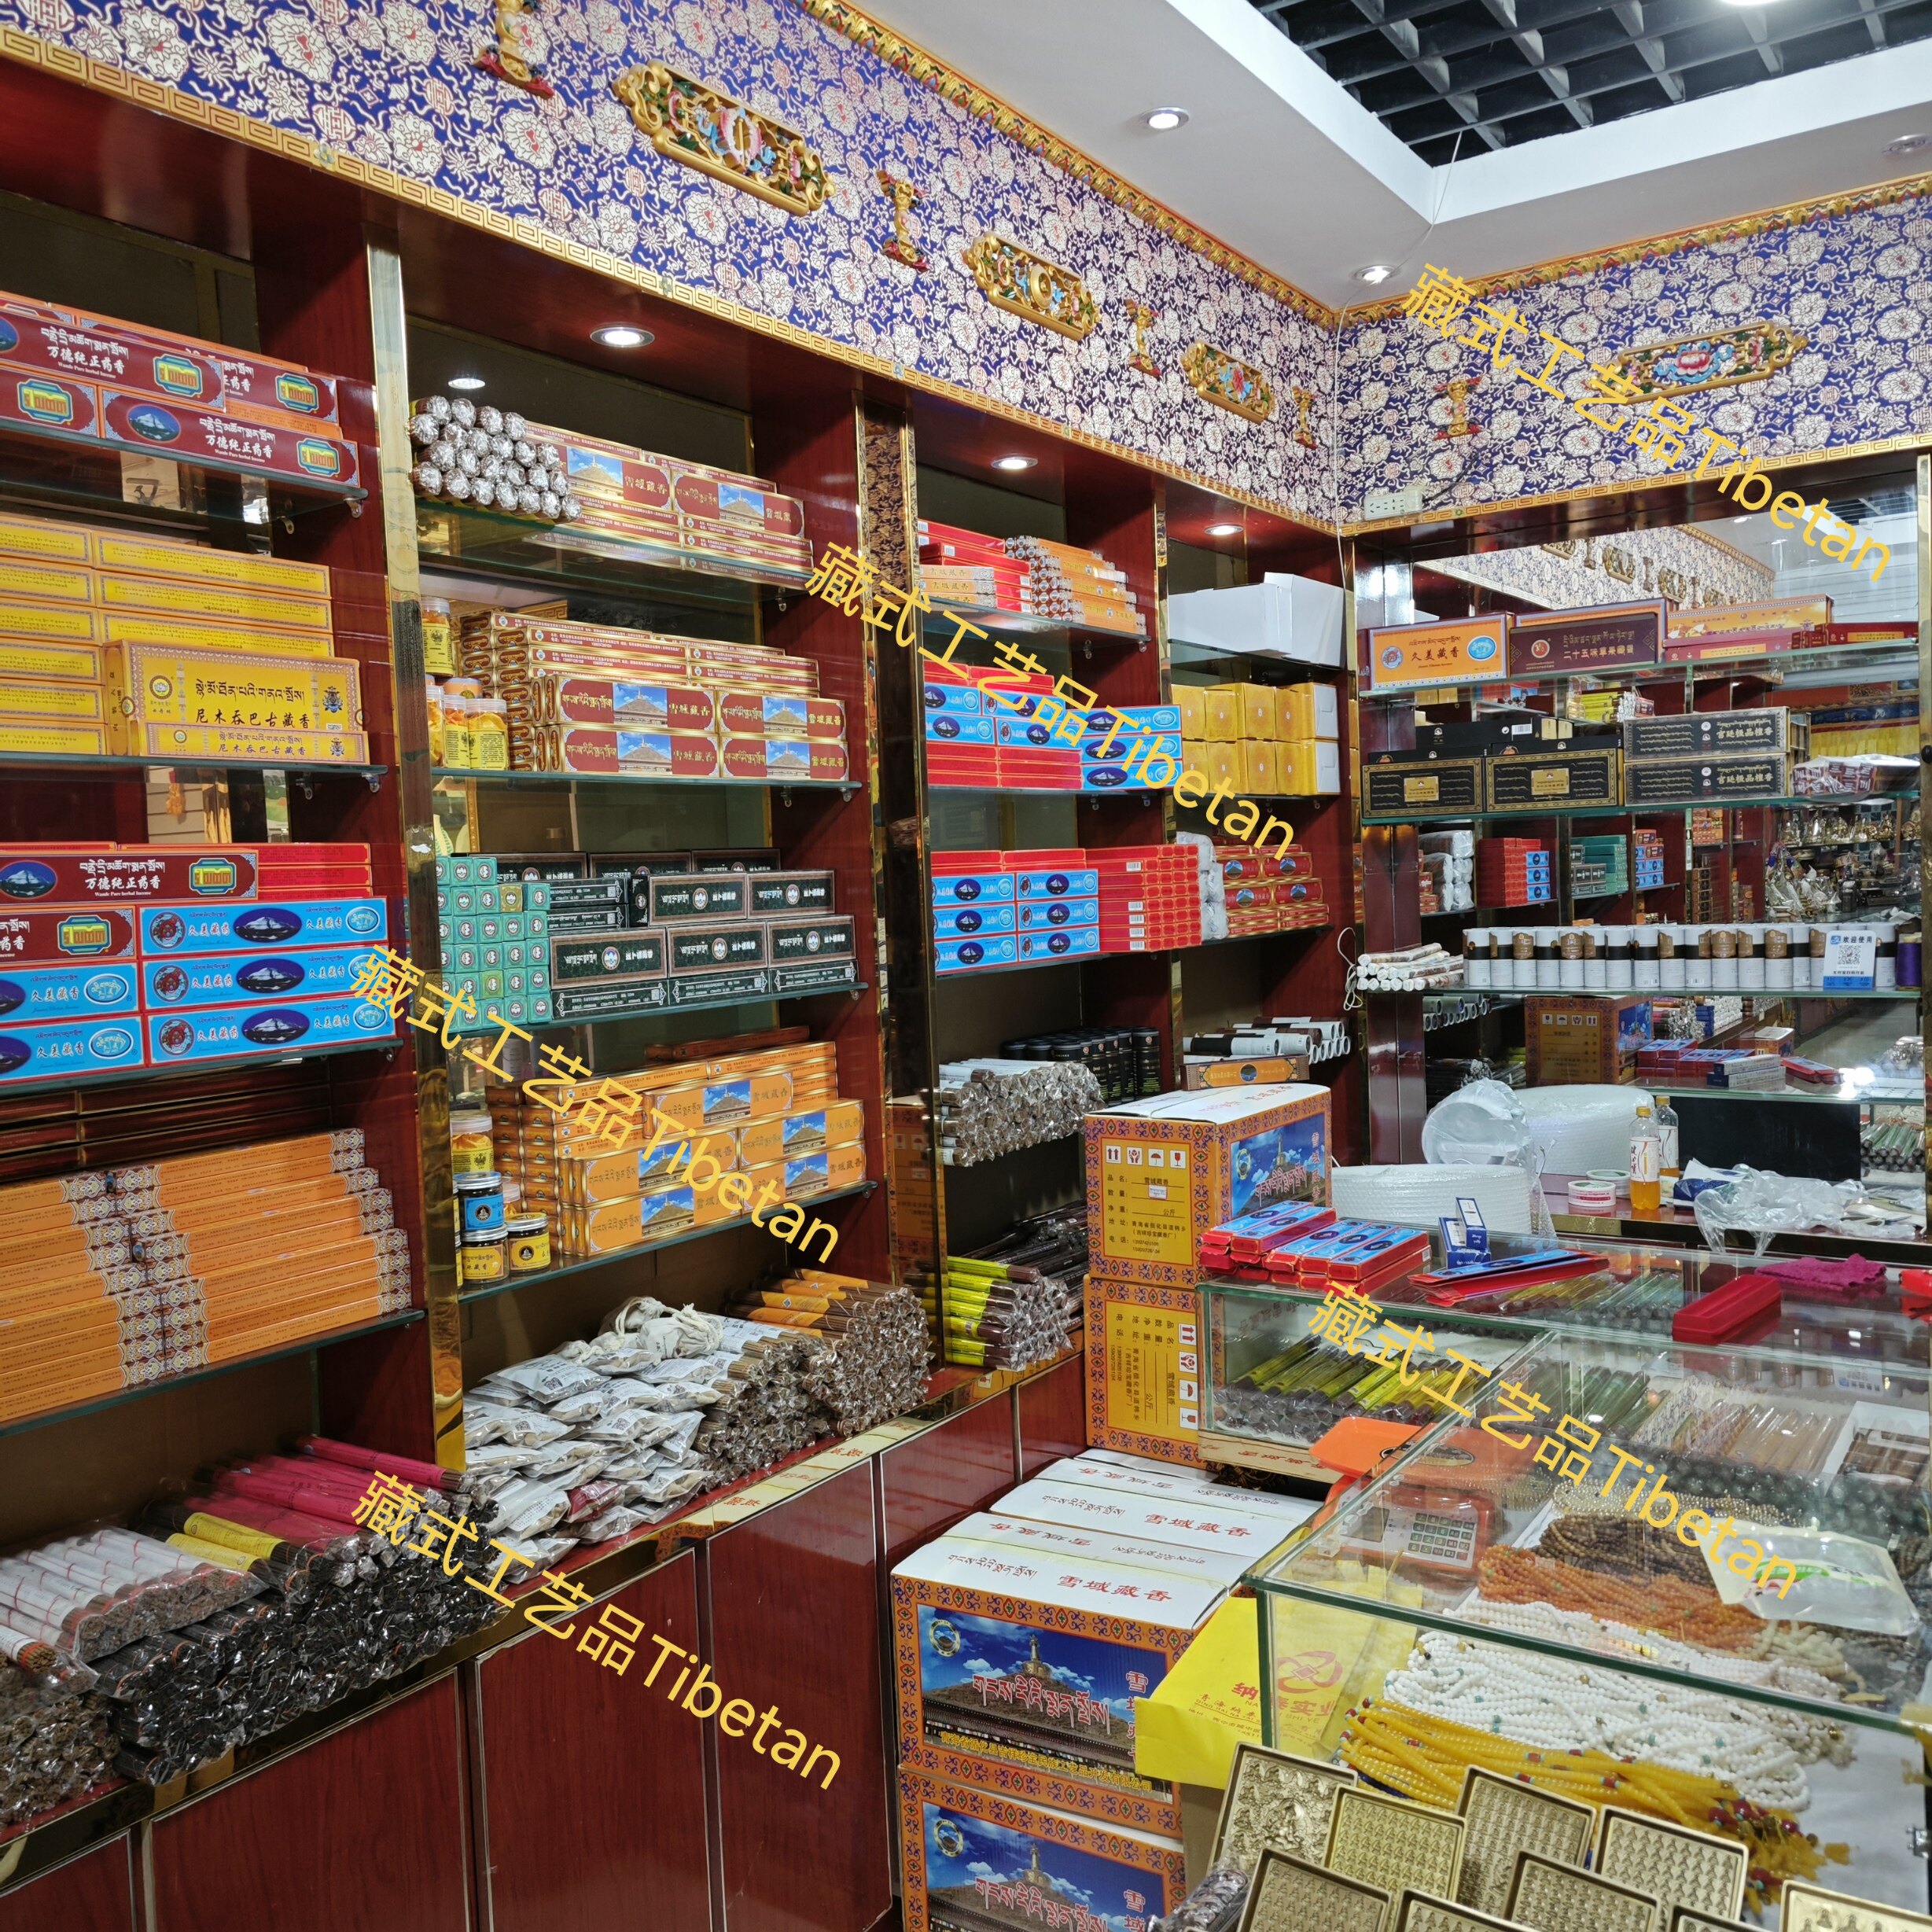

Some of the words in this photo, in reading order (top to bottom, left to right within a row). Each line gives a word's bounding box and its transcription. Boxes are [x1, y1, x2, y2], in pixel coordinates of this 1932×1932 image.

[47, 346, 125, 374] 万德纯正药香
[205, 435, 273, 458] 万德纯正药香
[1411, 646, 1459, 661] 久美藏香
[196, 708, 311, 729] 尼木吞巴古藏香
[218, 743, 306, 756] 尼木吞巴古藏香
[85, 875, 160, 889] 万德纯正药香
[31, 986, 79, 1001] 久美藏香
[36, 1042, 84, 1058] 久美藏香
[1145, 1514, 1252, 1537] 雪域藏香
[1058, 1576, 1173, 1602] 雪域藏香
